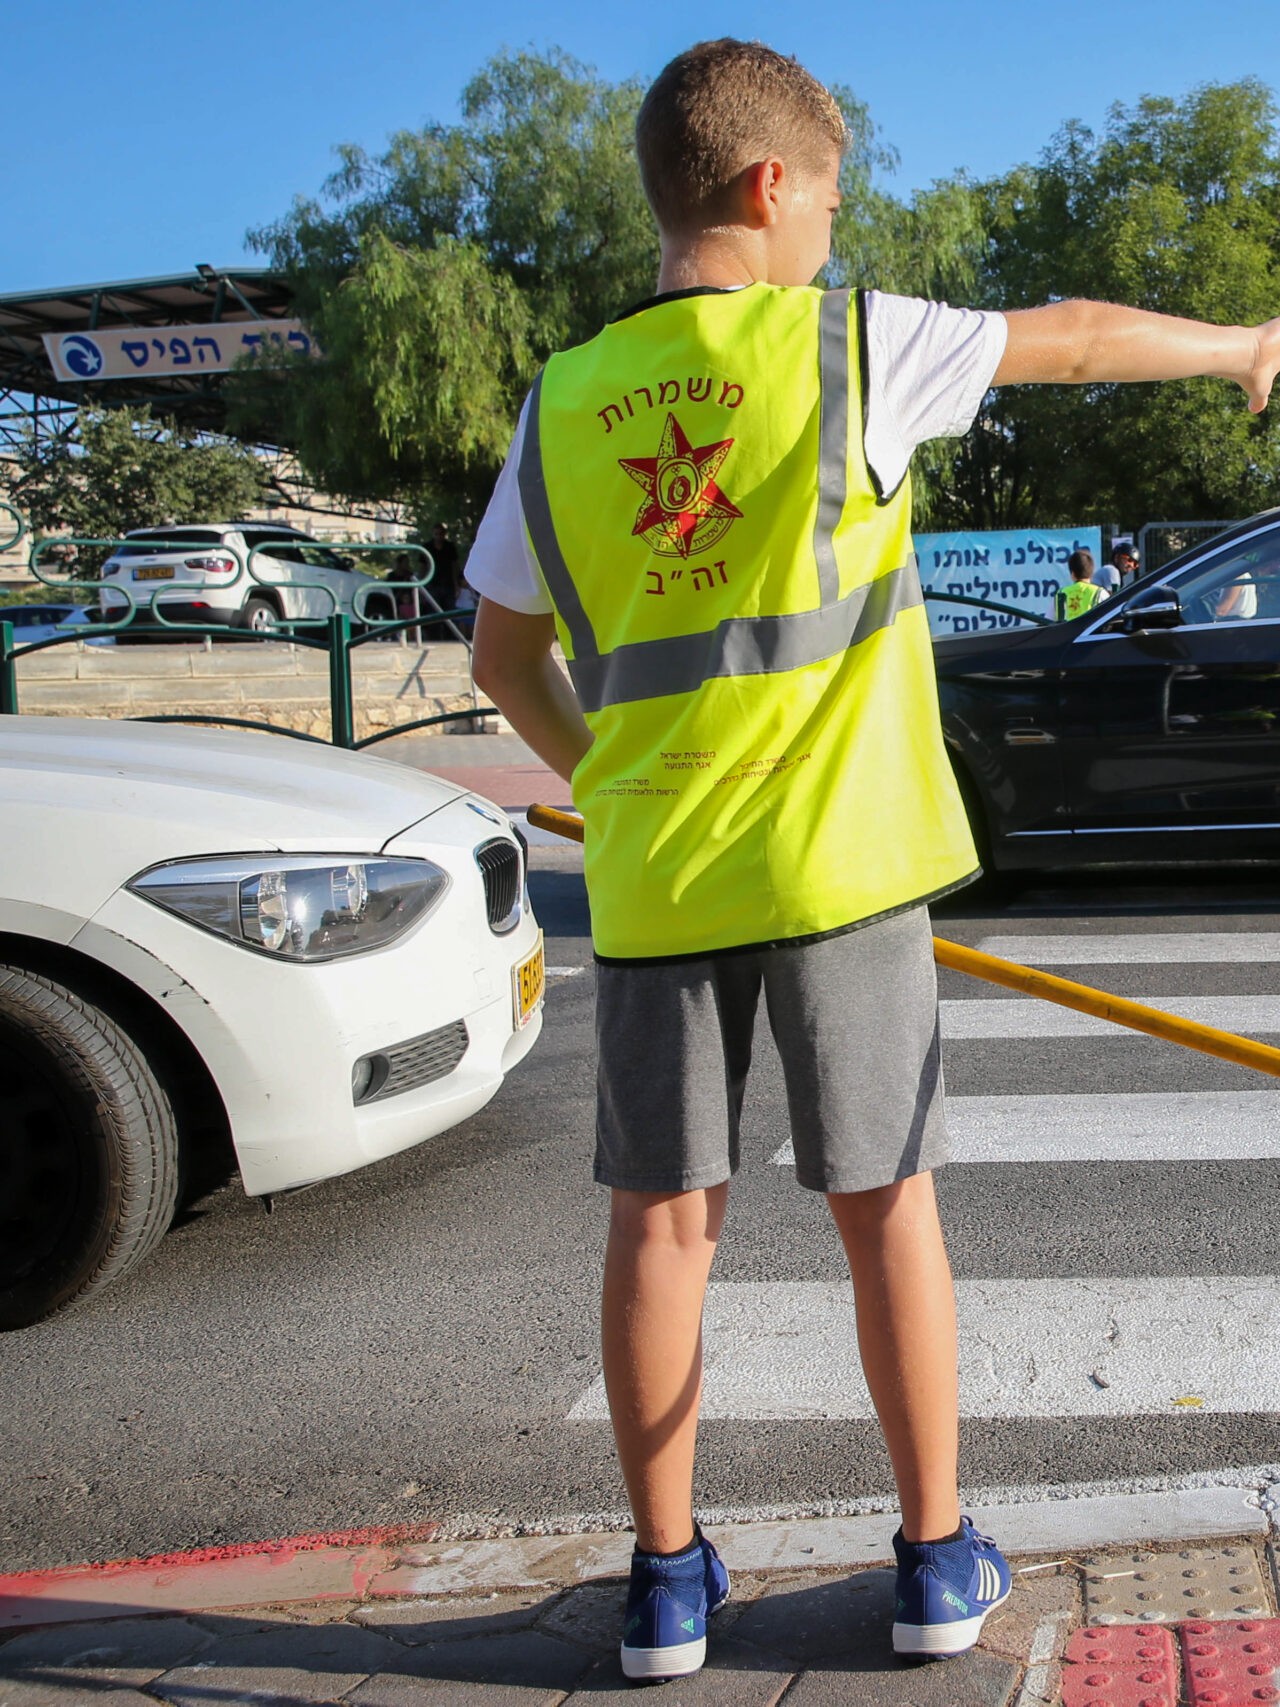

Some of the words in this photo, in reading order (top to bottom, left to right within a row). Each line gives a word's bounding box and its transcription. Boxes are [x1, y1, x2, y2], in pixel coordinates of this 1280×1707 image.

[121, 336, 221, 367] הפיס
[597, 377, 745, 433] משמרות
[933, 549, 991, 568] אותו
[645, 560, 729, 595] זה"ב
[947, 576, 1061, 600] מתחילים
[684, 751, 717, 759] משטרת
[942, 1590, 969, 1617] PREDATOR
